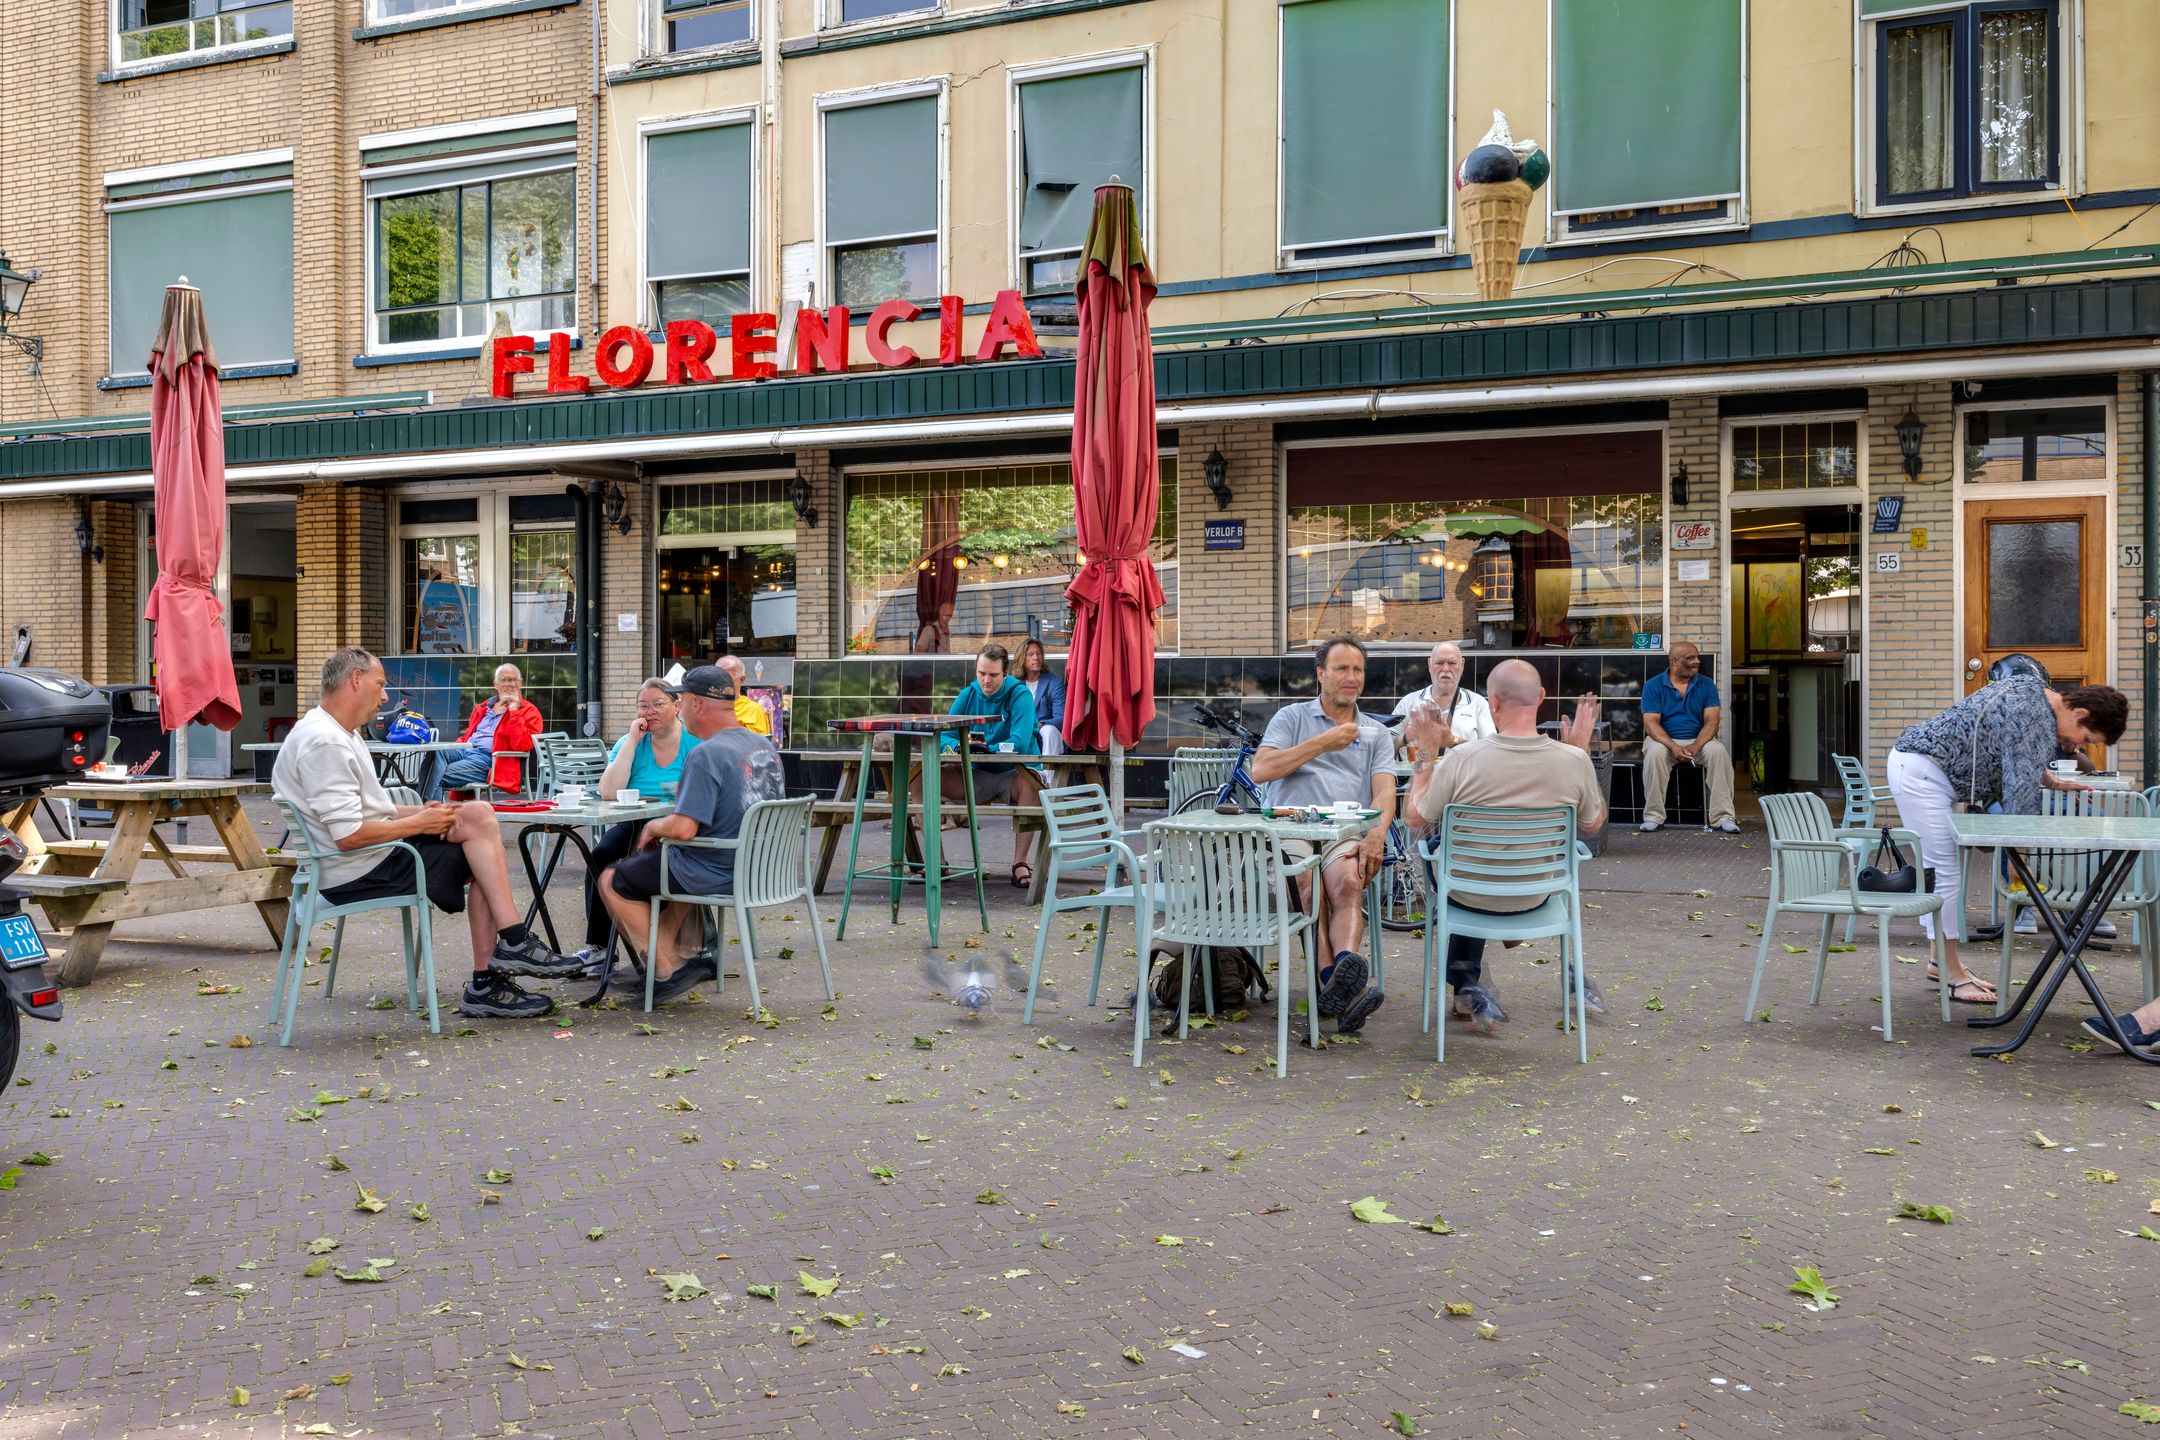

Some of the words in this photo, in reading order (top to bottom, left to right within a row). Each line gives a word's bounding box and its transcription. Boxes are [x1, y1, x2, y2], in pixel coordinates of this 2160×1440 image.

[492, 289, 1044, 398] FLORENCIA
[1204, 527, 1236, 538] VERLOF
[1237, 526, 1243, 537] B
[1677, 523, 1710, 540] Coffee
[1879, 554, 1898, 569] 55
[2125, 545, 2142, 566] 53
[5, 920, 30, 938] FSV
[14, 937, 40, 955] 11X
